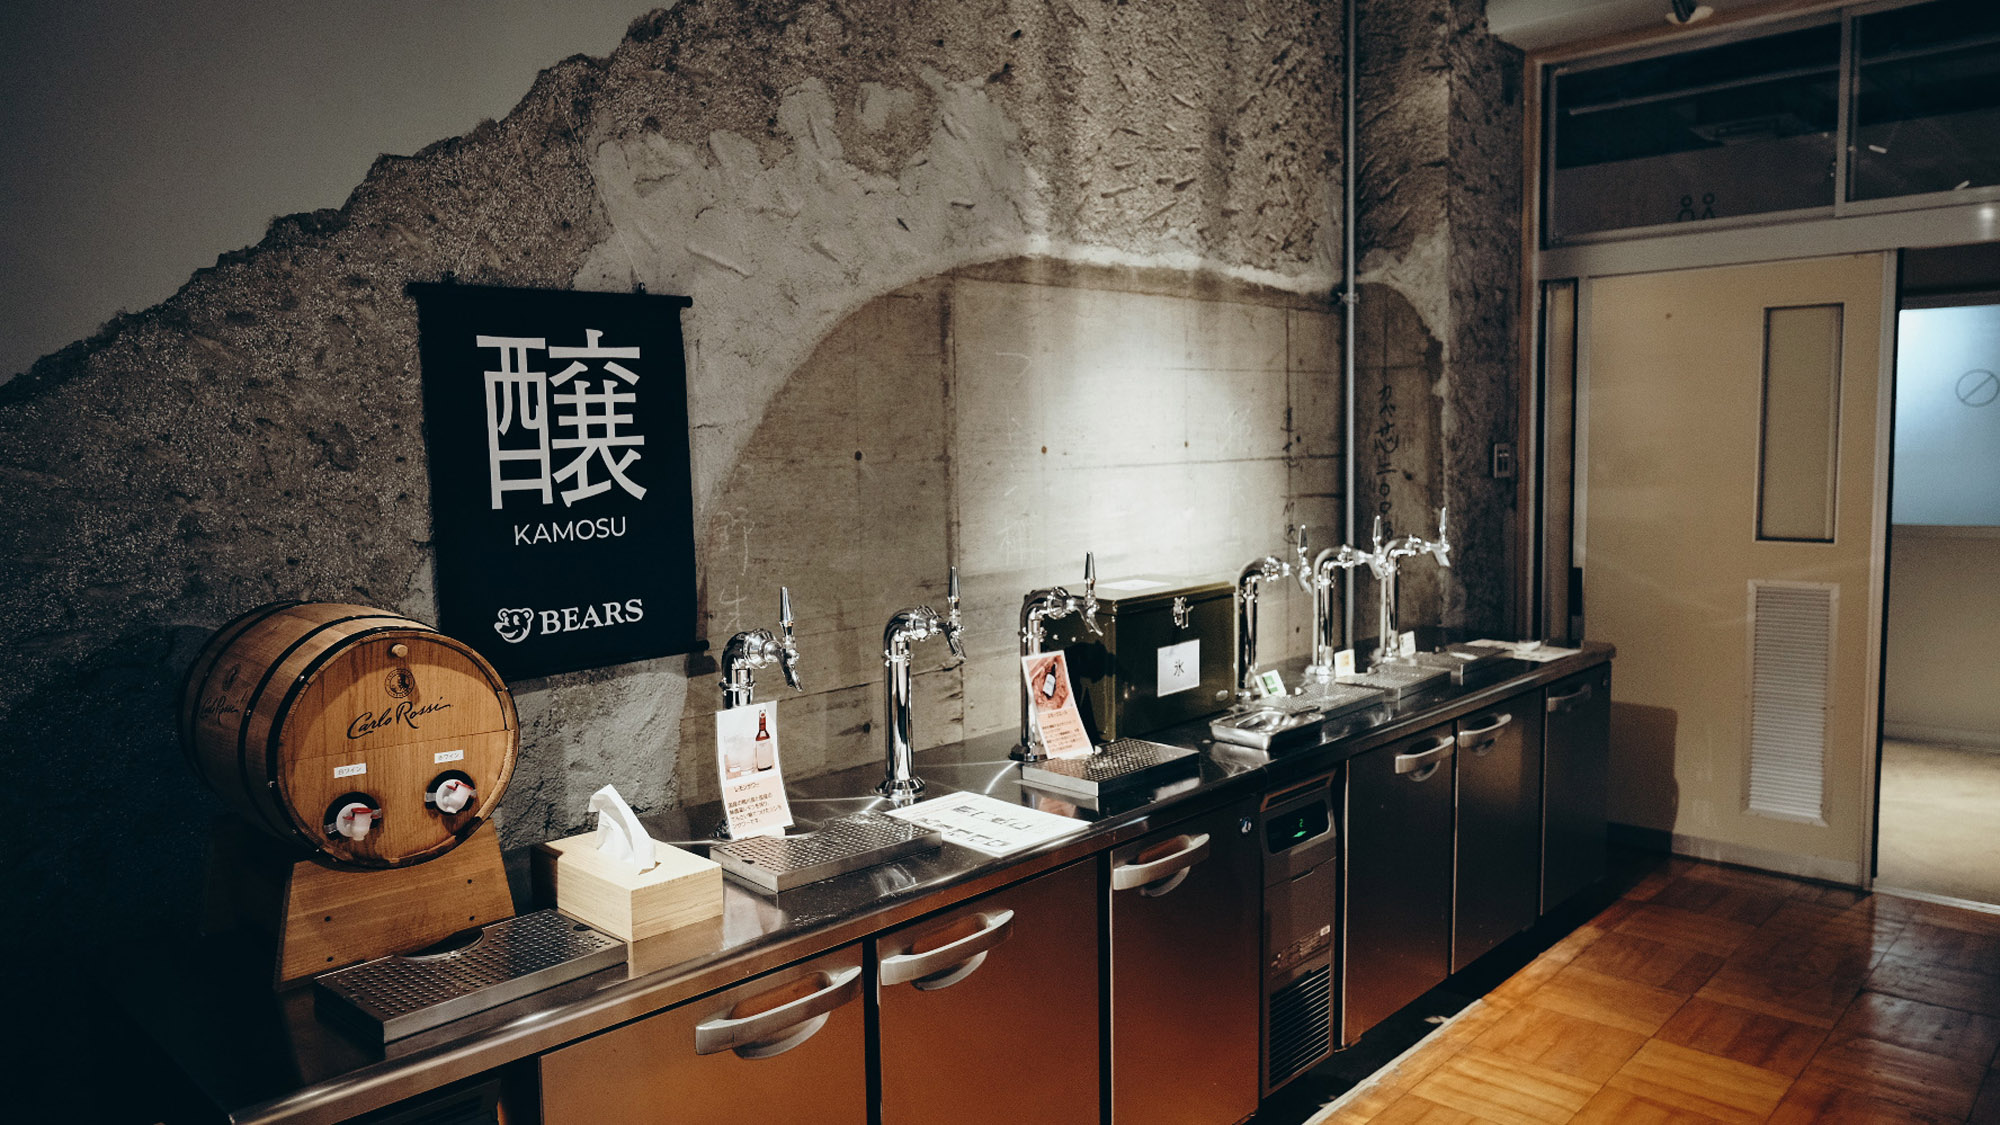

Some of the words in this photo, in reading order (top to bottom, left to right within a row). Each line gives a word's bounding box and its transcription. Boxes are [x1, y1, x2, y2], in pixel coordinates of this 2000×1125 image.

[476, 328, 647, 510] 醸
[514, 516, 626, 545] KAMOSU
[538, 599, 643, 635] BEARS
[347, 707, 392, 739] Carlo
[396, 697, 451, 729] Rossi
